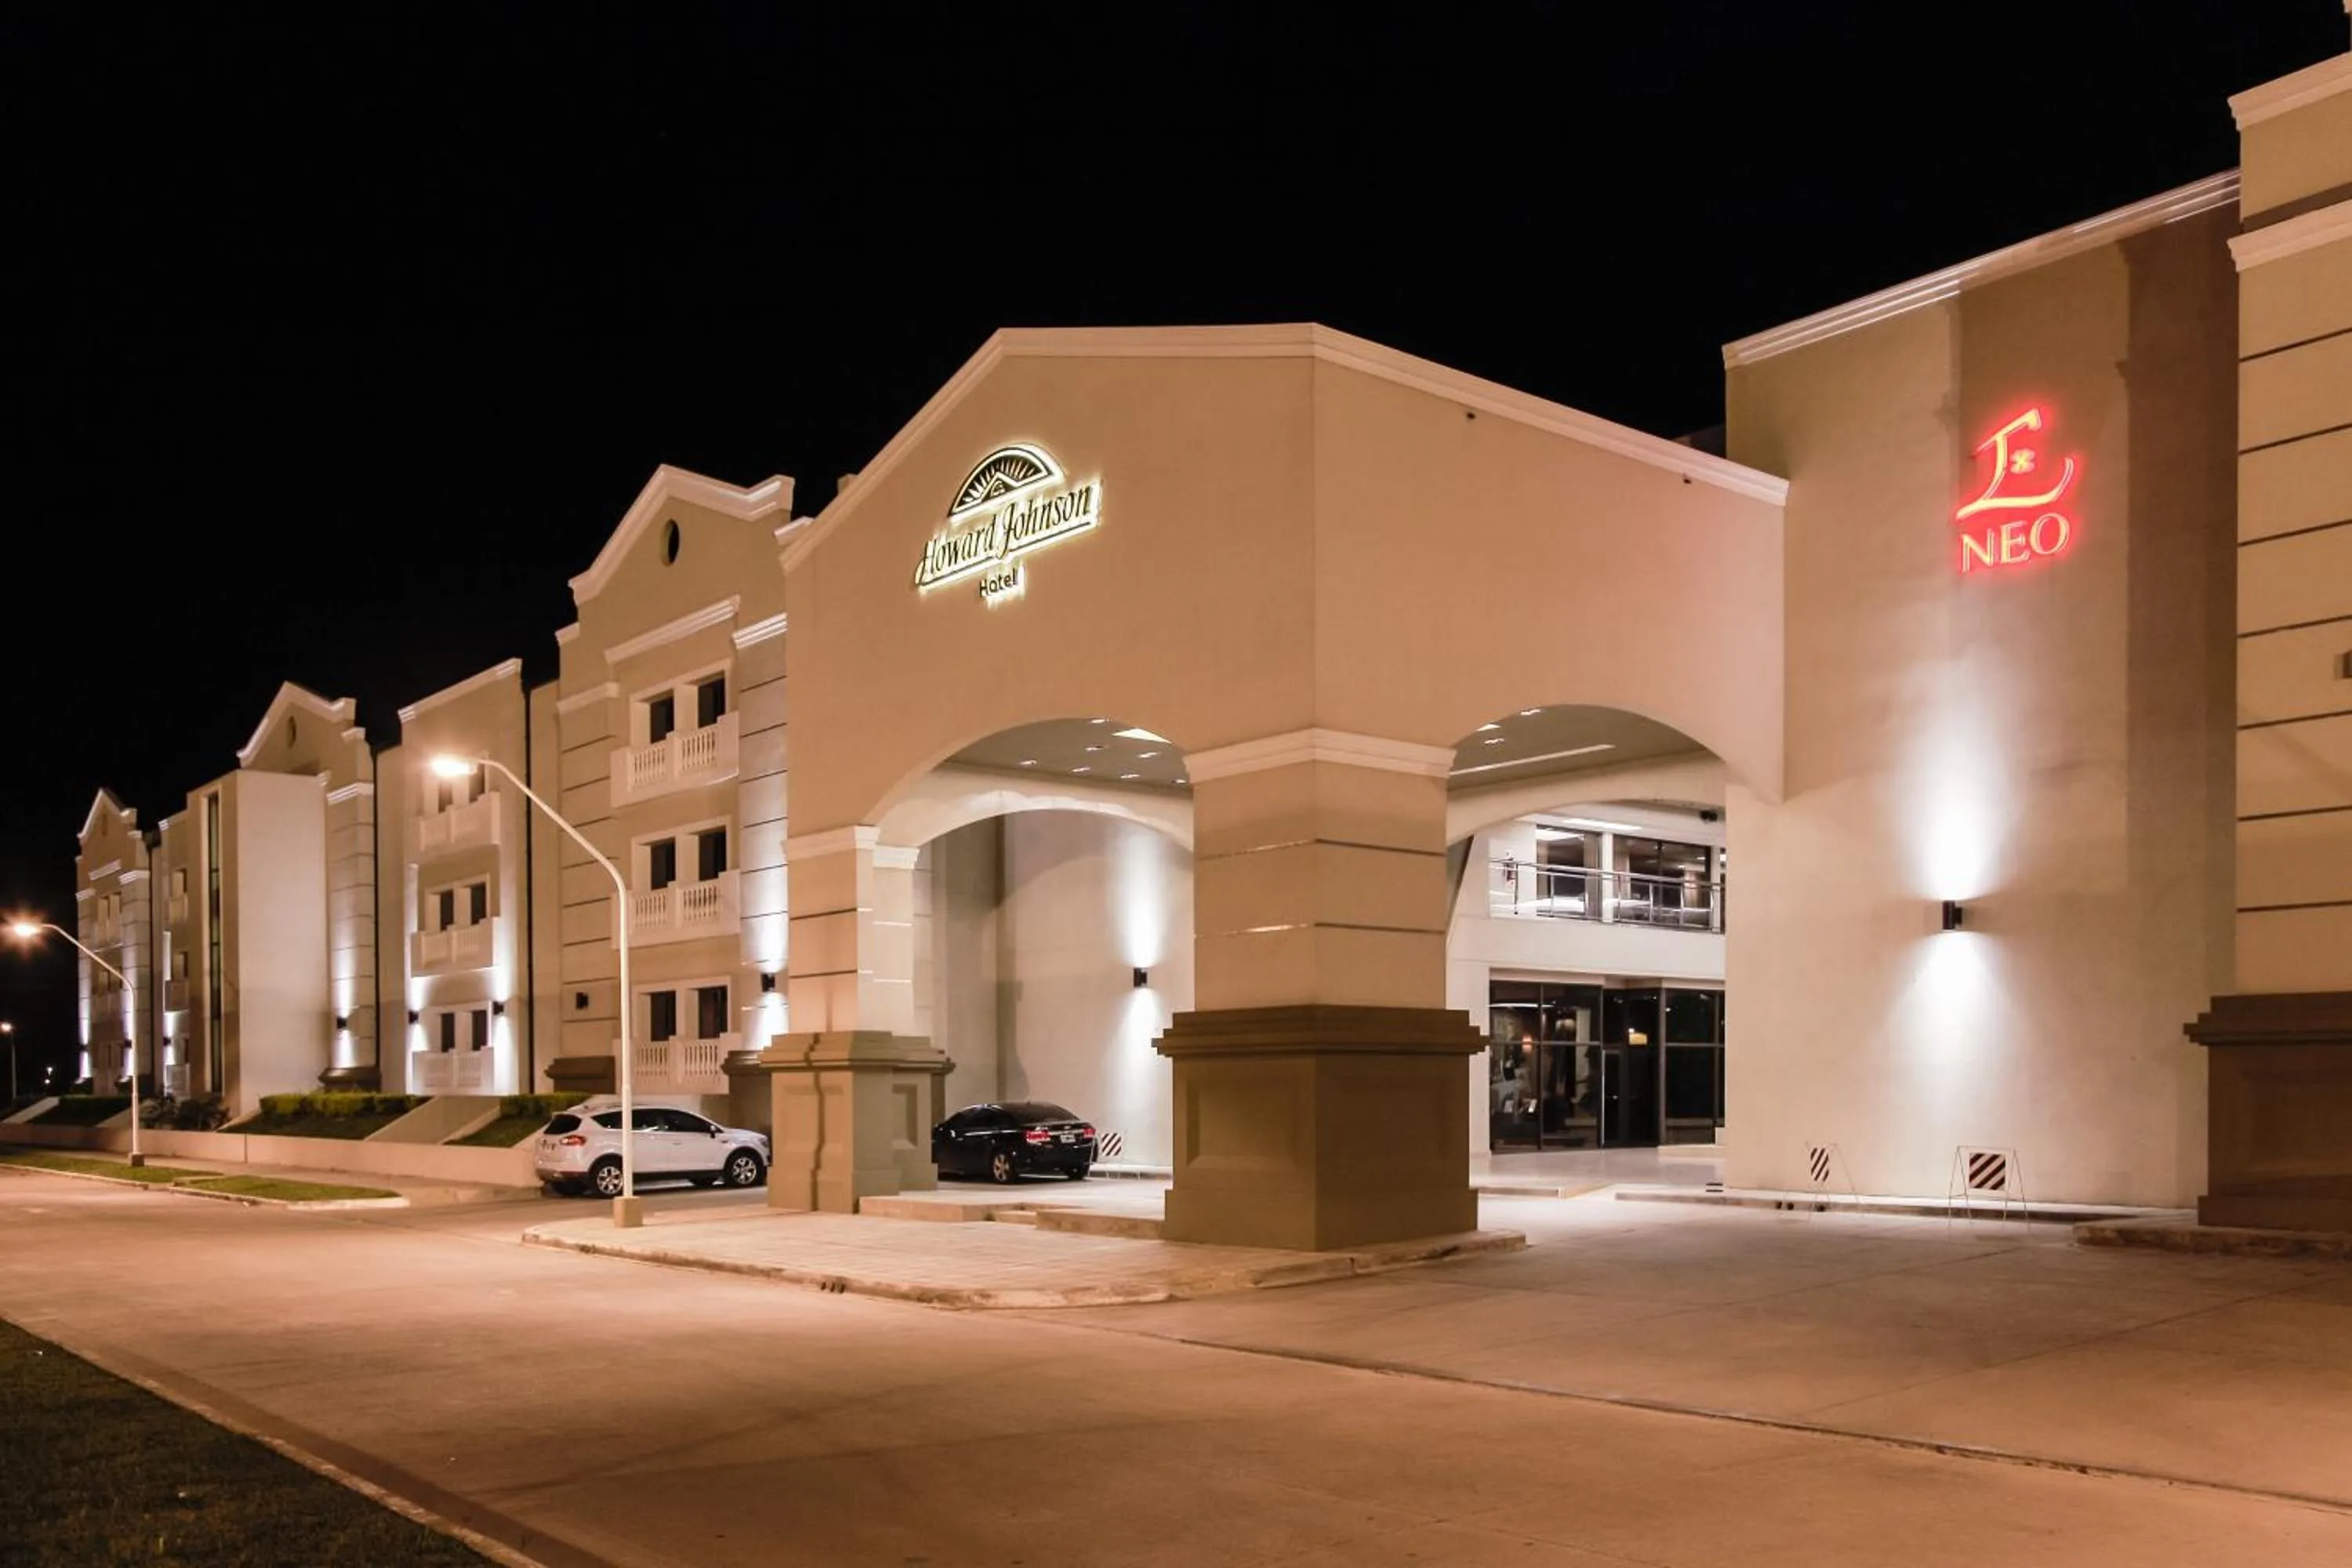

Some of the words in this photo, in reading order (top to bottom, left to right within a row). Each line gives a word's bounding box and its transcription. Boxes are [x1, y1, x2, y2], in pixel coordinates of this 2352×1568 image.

[914, 513, 996, 586] Howard
[996, 485, 1091, 560] Johnson
[1961, 512, 2071, 573] NEO
[979, 568, 1017, 597] Hotel
